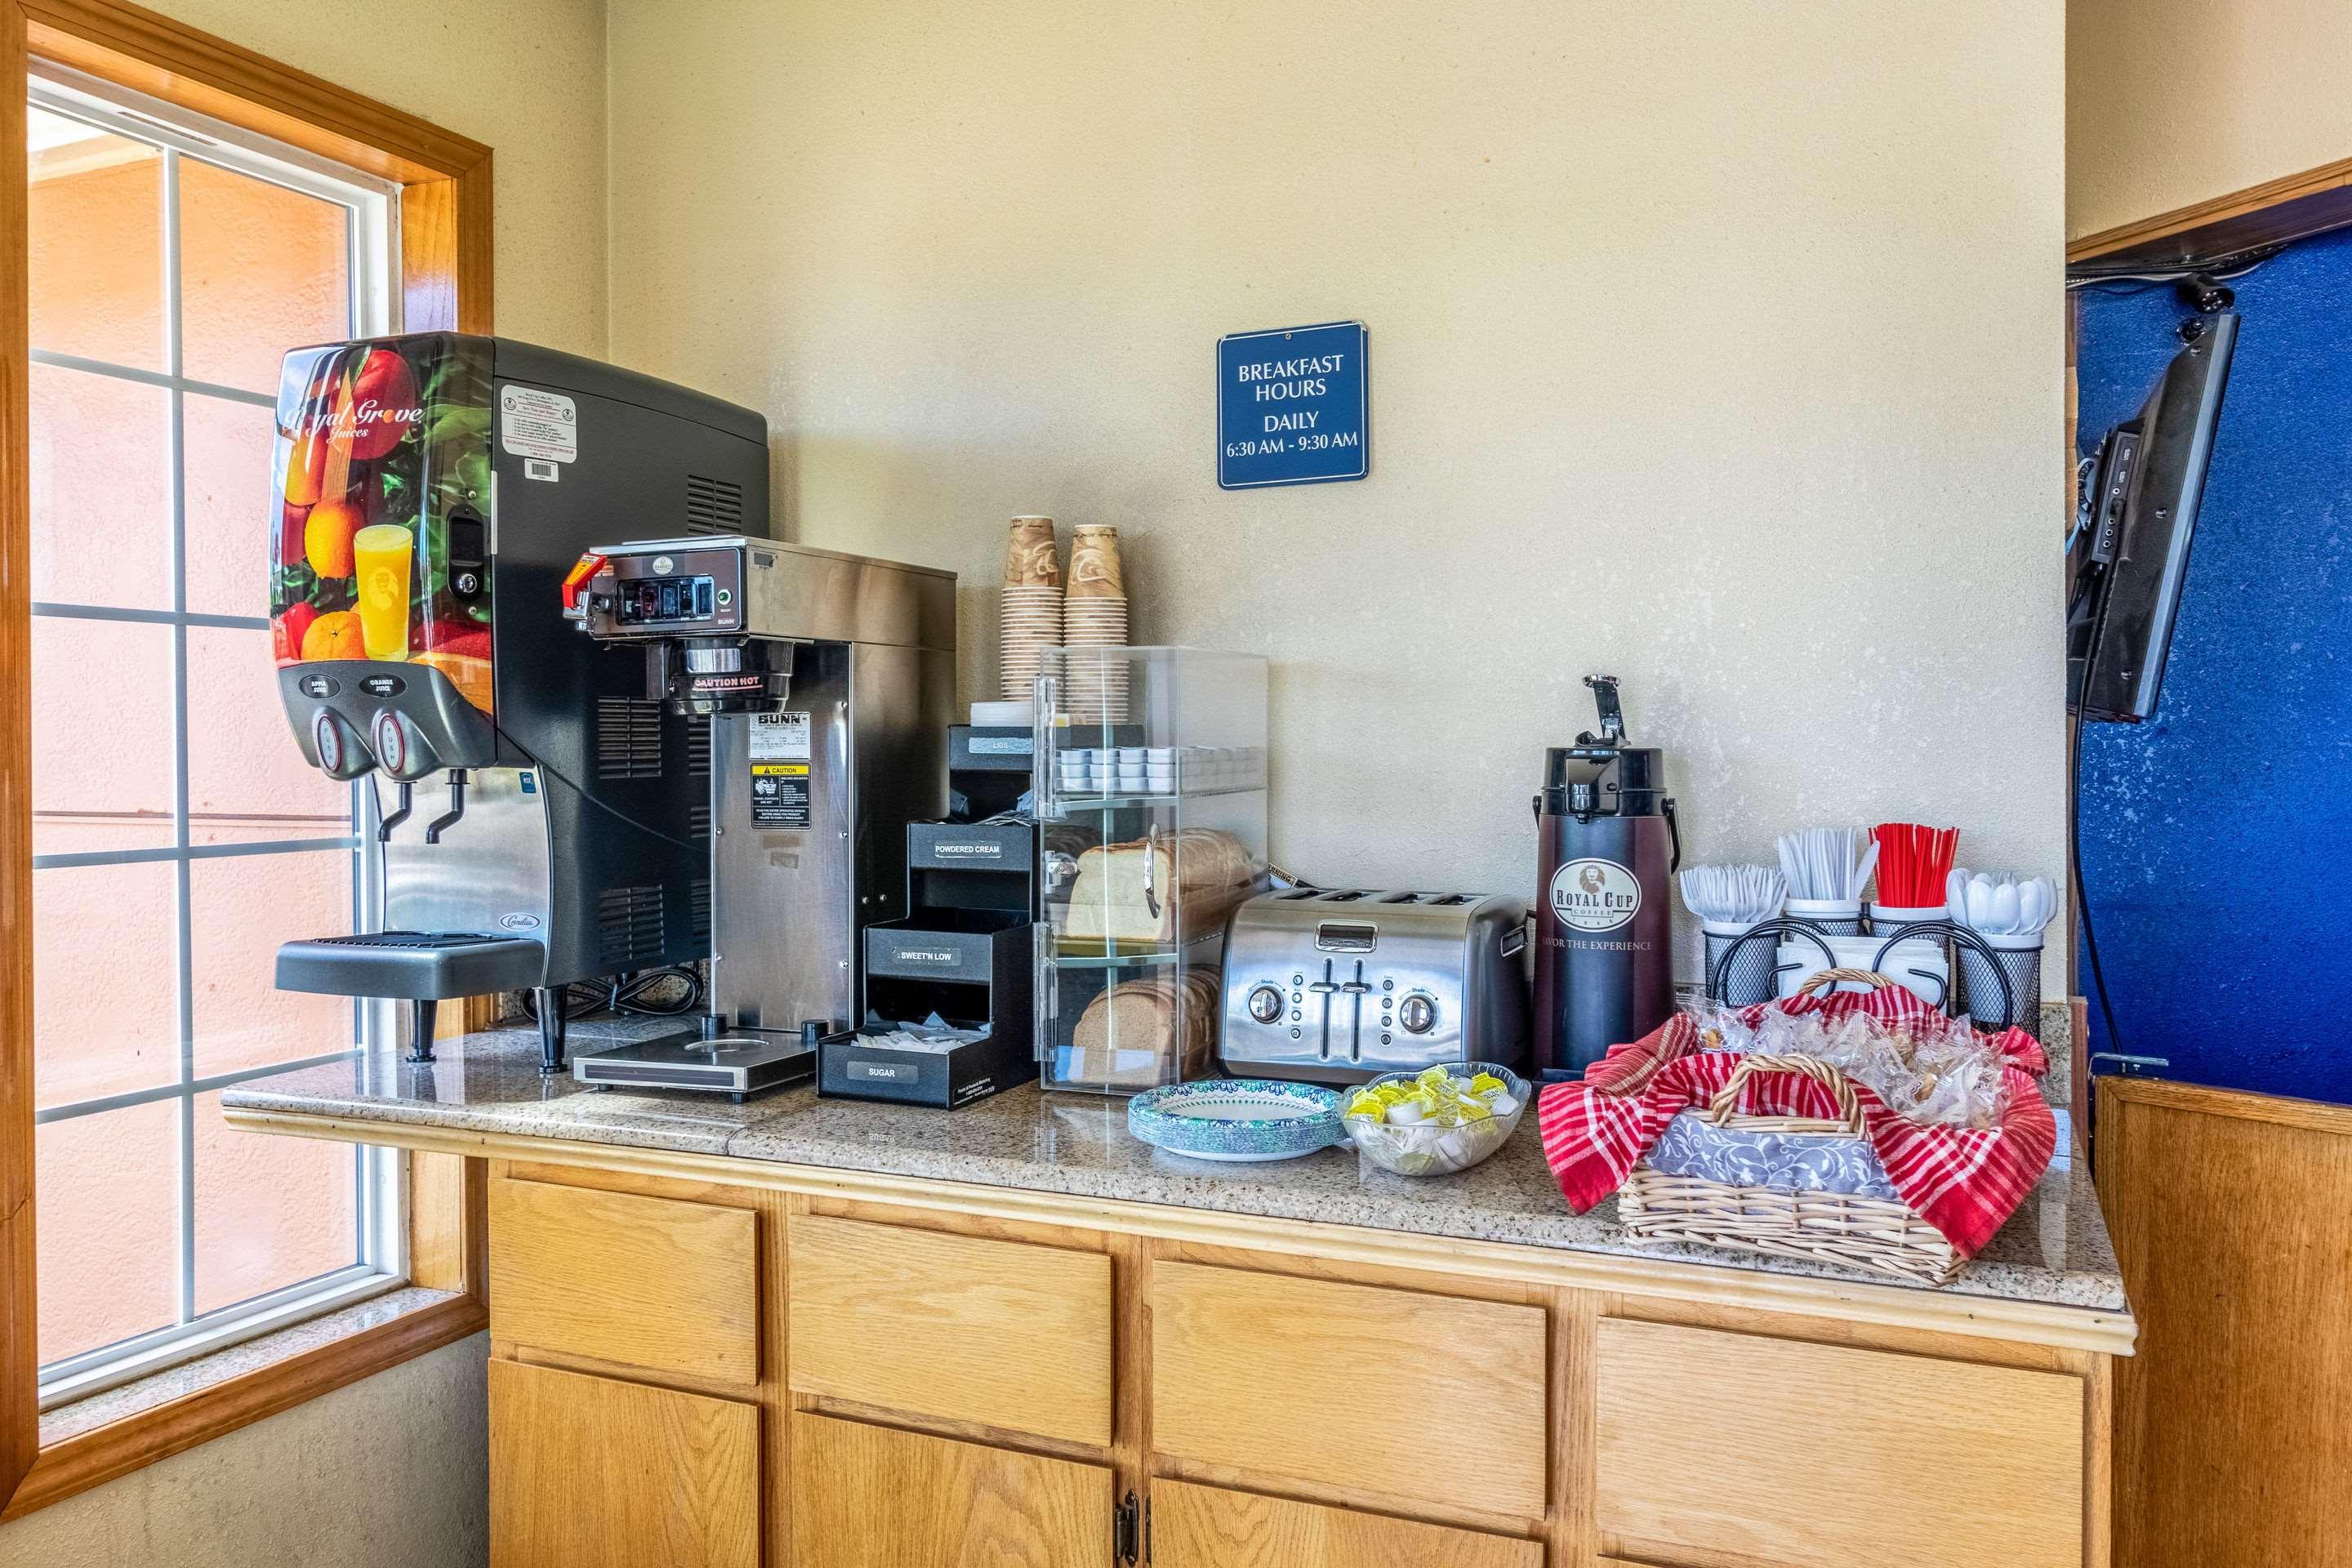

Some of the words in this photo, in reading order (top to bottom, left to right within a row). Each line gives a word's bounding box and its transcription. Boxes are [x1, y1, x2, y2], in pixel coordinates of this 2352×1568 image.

[1239, 354, 1343, 382] BREAKFAST
[1256, 378, 1326, 402] HOURS
[353, 399, 425, 425] Grove
[1264, 411, 1319, 432] DAILY
[327, 426, 369, 444] Juices
[1227, 441, 1255, 457] 6:30
[1258, 438, 1284, 455] AM
[1298, 434, 1328, 451] 9:30
[1331, 430, 1358, 448] AM
[694, 679, 738, 688] CAUTION
[740, 677, 760, 686] HOT
[758, 714, 800, 724] BUNN
[935, 845, 974, 853] POWDERED
[974, 845, 1000, 853] CREAM
[1557, 889, 1600, 907] ROYAL
[1604, 892, 1633, 907] CUP
[1566, 939, 1588, 949] THE
[1590, 940, 1652, 951] EXPERIENCE
[901, 951, 933, 960] SWEET'N
[934, 952, 952, 961] LOW
[868, 1067, 896, 1078] SUGAR
